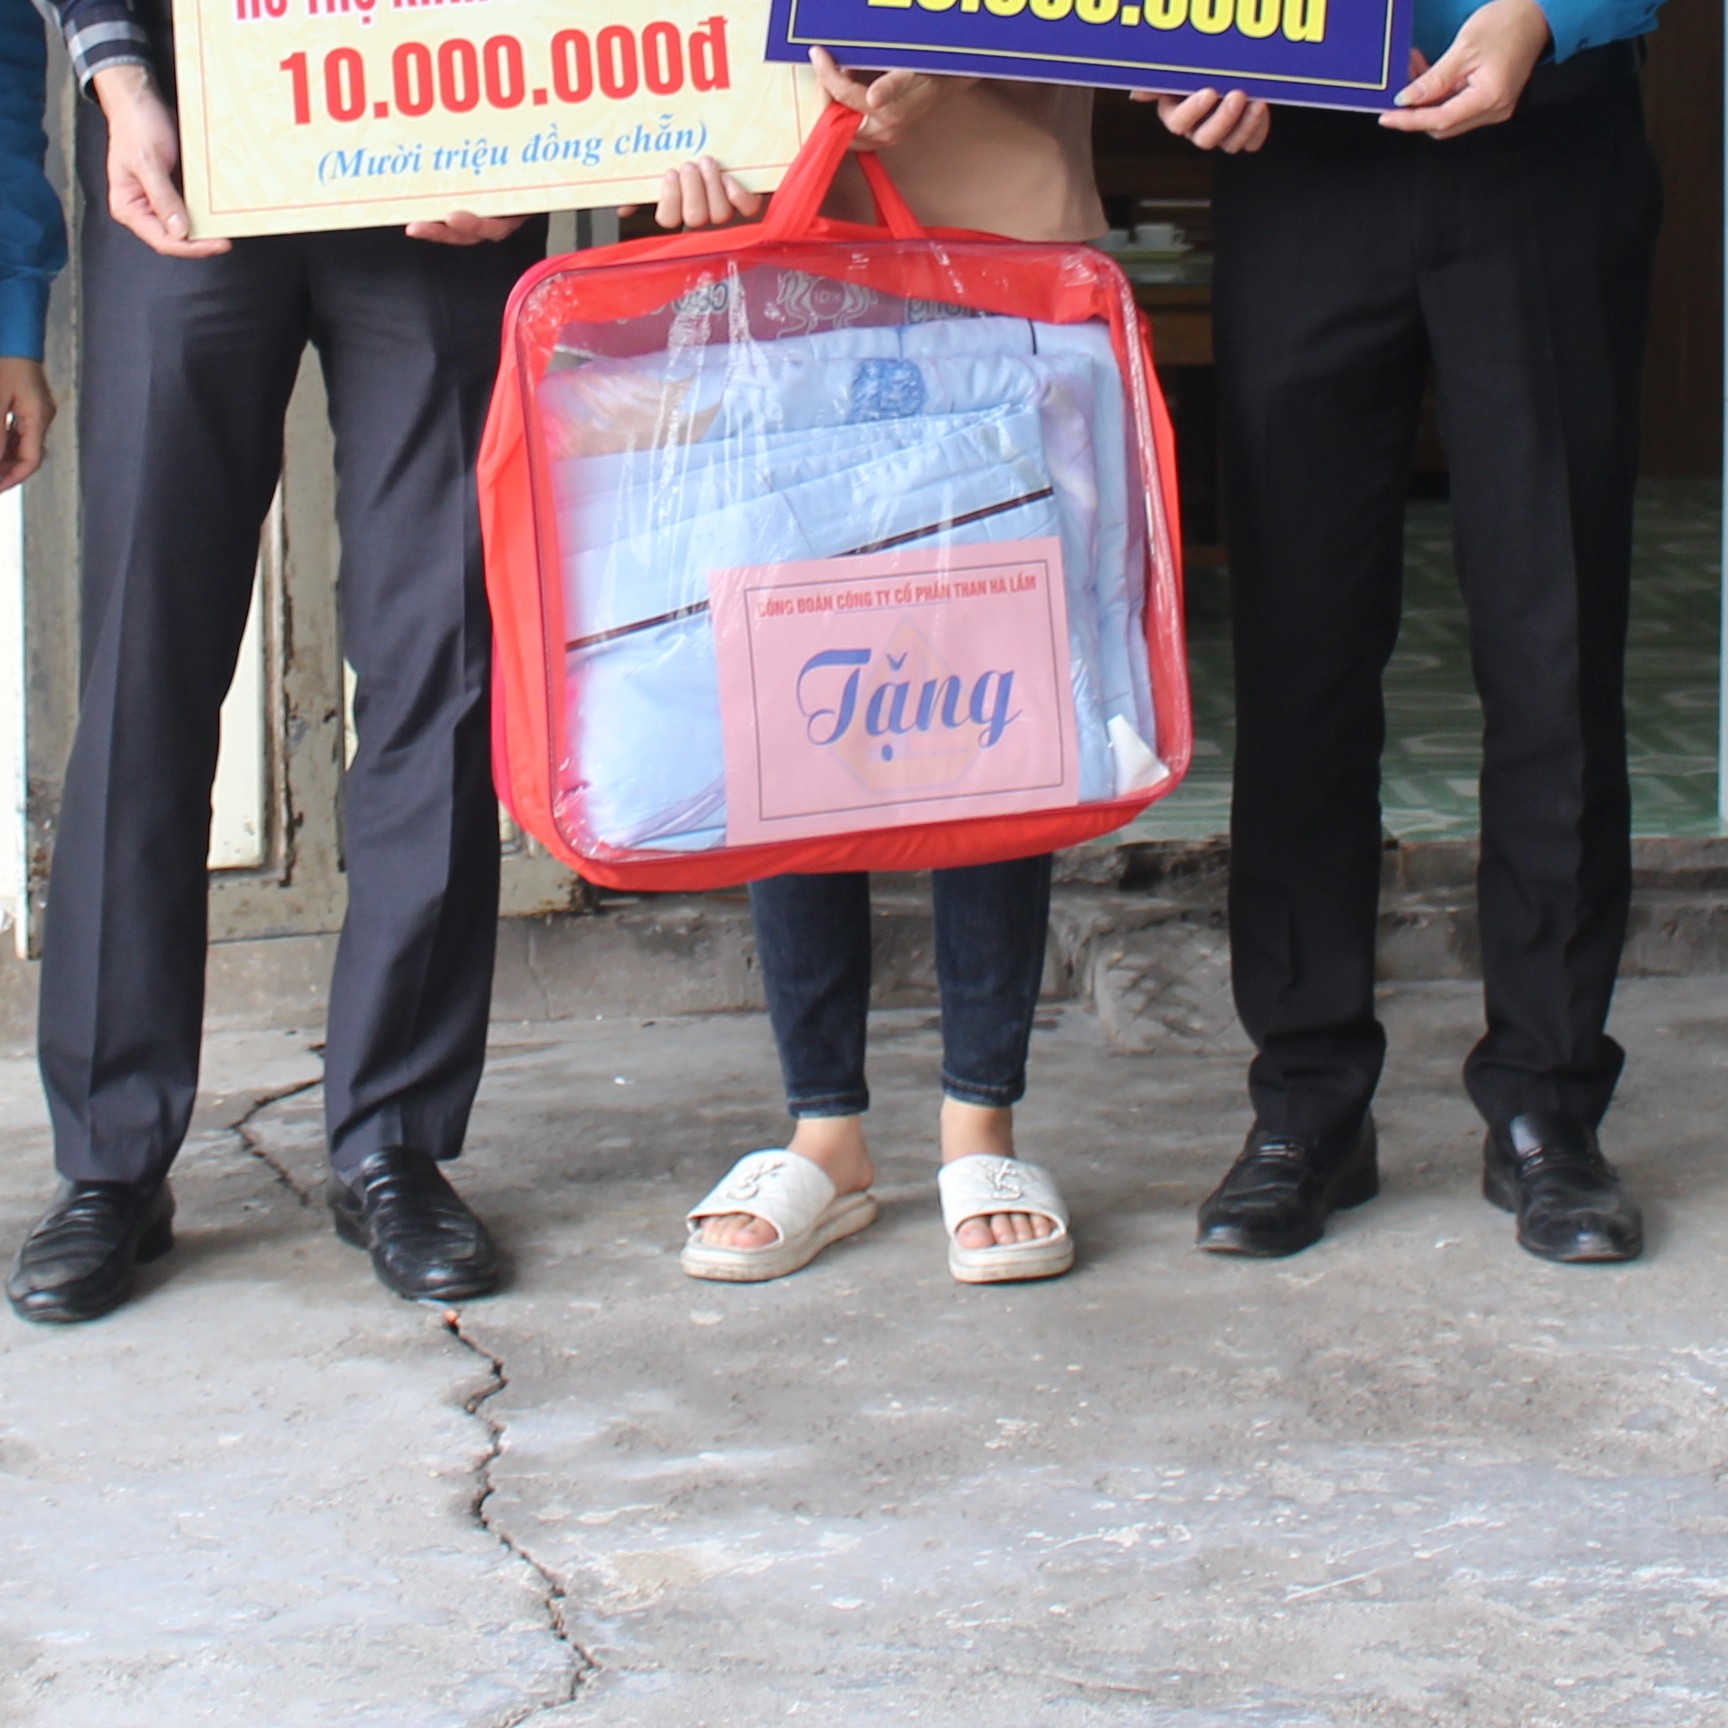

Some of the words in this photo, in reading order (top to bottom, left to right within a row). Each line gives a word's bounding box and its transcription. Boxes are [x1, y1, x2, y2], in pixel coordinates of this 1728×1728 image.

[279, 16, 732, 125] 10.000.000đ
[317, 143, 422, 185] (Mười
[432, 136, 510, 177] triệu
[521, 125, 603, 172] đồng
[614, 113, 709, 156] chẵn)
[836, 589, 873, 610] CÔNG
[876, 588, 891, 605] TY
[954, 578, 987, 598] THAN
[990, 575, 1007, 594] HÀ
[796, 648, 1023, 762] Tặng
